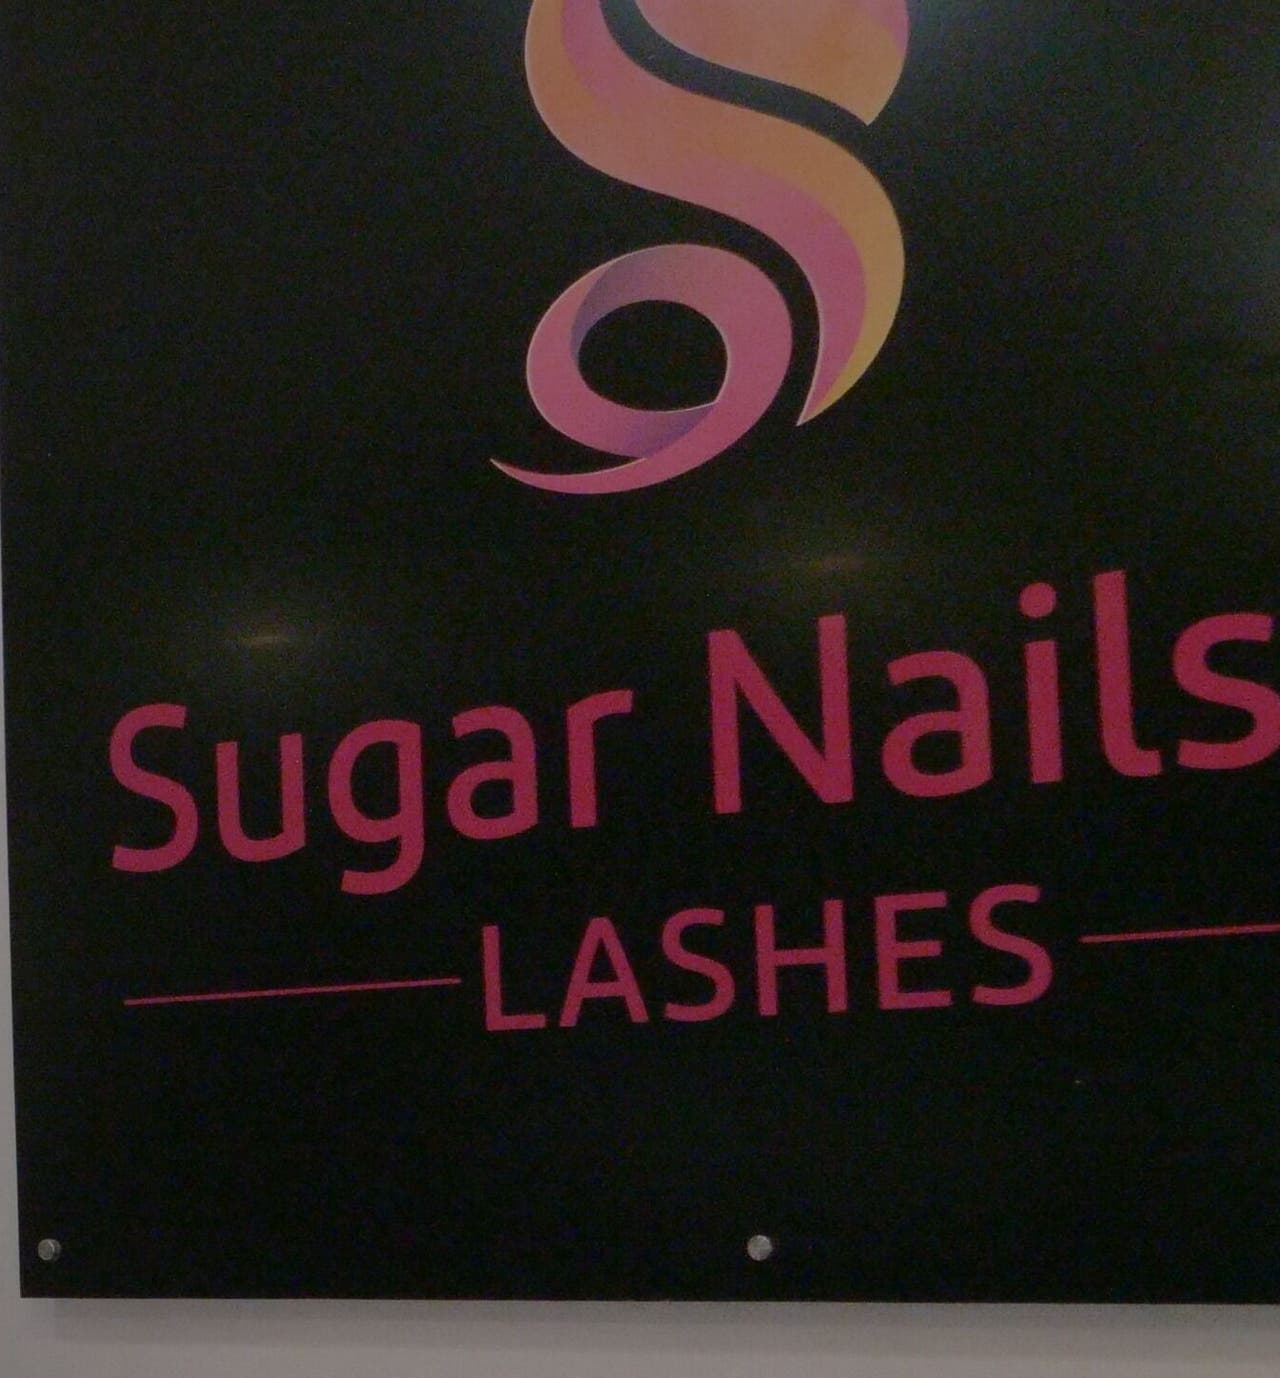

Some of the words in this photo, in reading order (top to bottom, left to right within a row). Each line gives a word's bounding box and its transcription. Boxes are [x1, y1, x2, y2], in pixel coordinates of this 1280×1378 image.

[107, 688, 633, 896] Sugar
[706, 569, 1280, 815] Nails
[481, 883, 1054, 1032] LASHES
